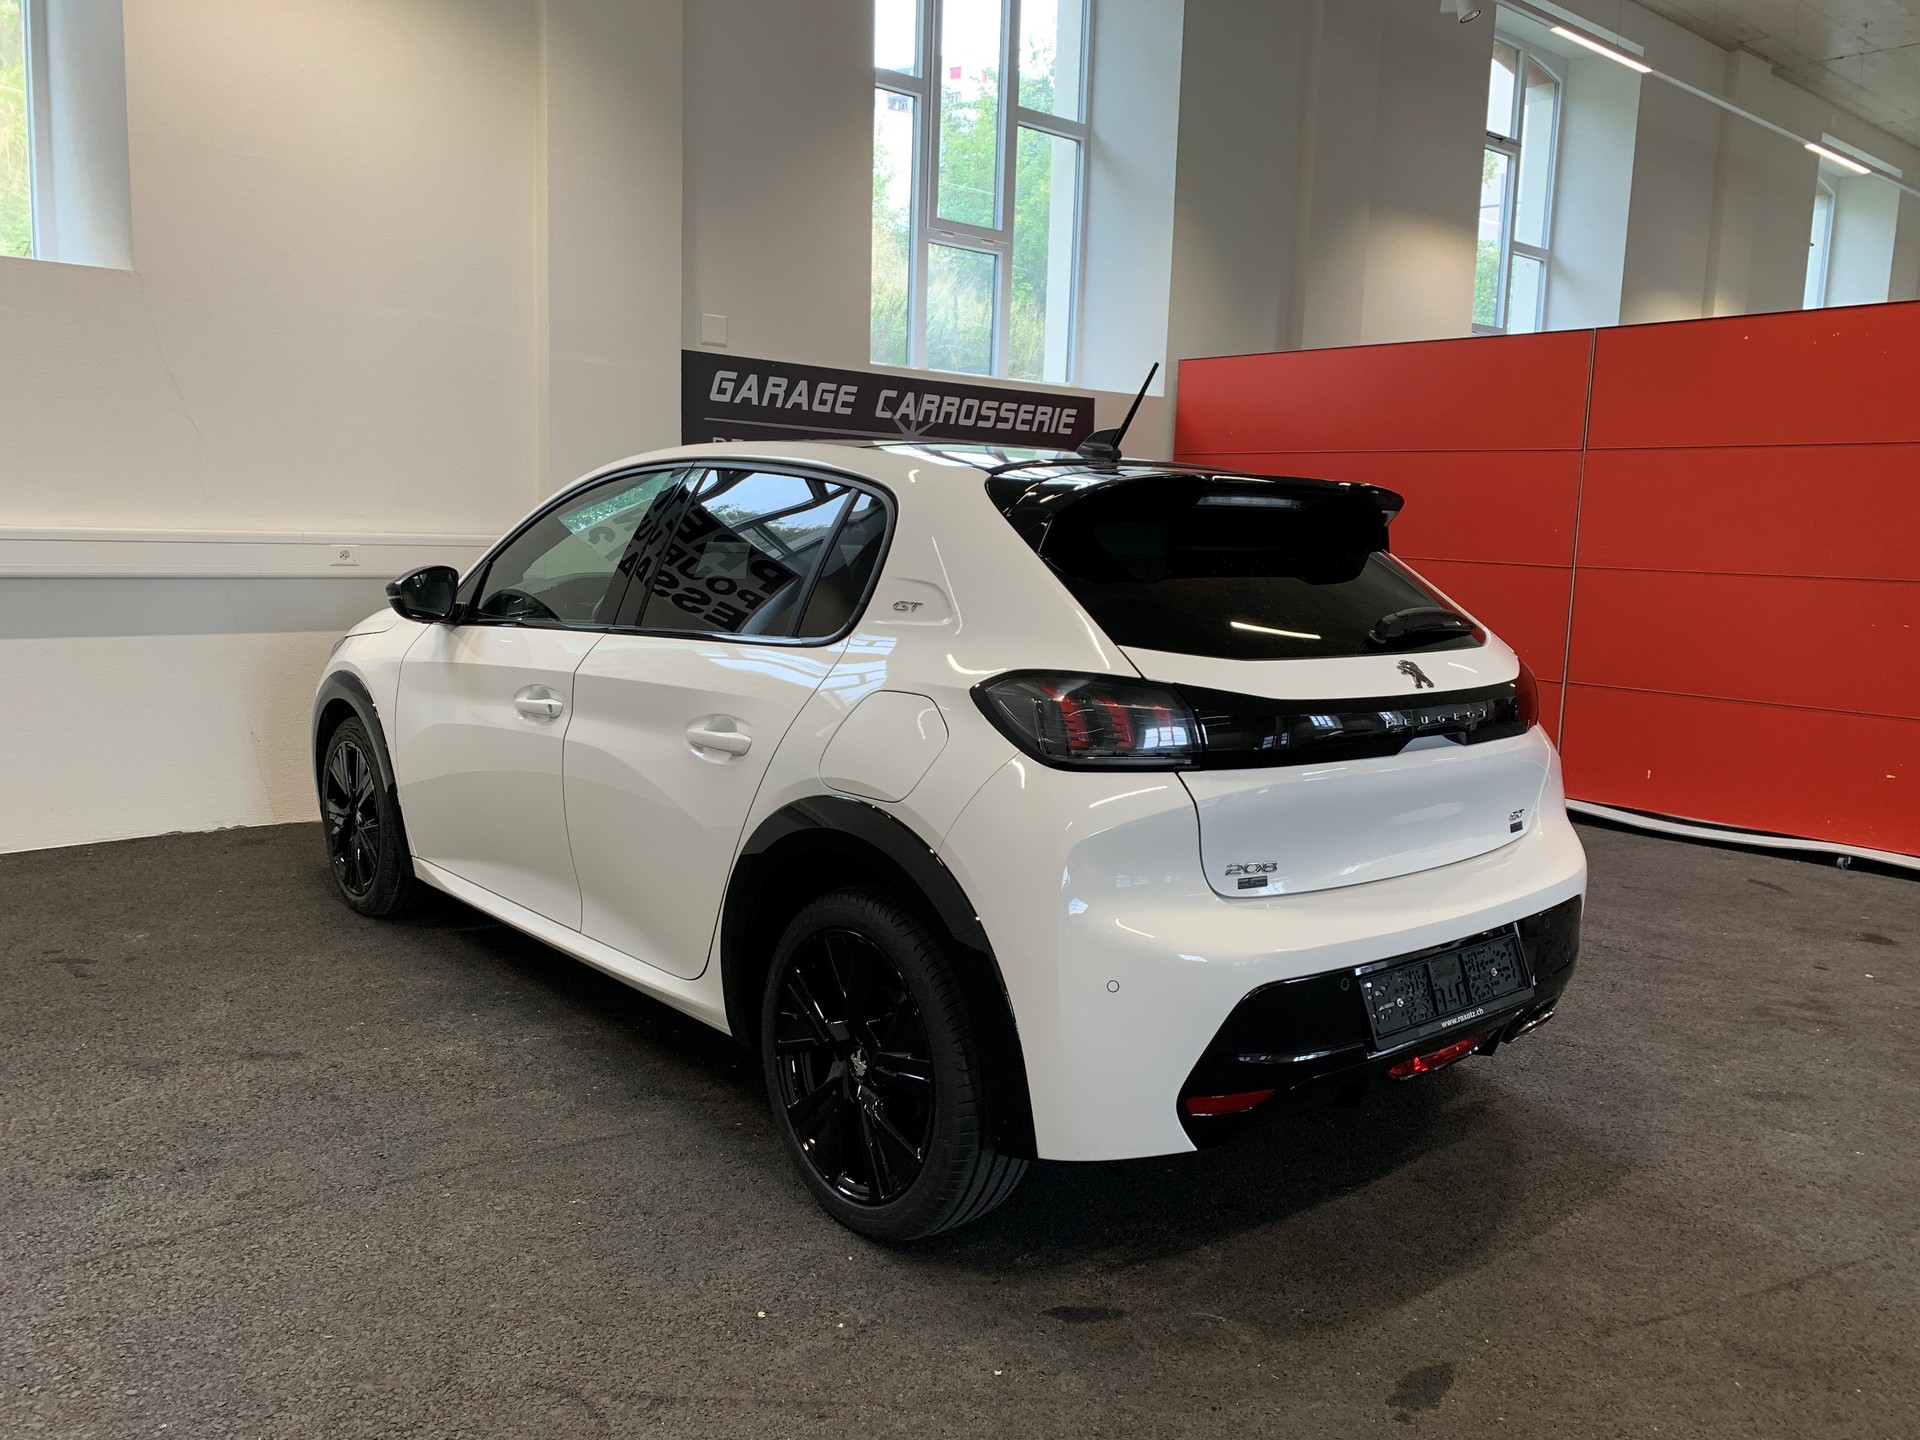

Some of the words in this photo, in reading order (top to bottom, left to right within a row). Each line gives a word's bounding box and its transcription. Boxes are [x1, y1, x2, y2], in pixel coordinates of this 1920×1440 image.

[710, 370, 858, 415] GARAGE
[875, 389, 1077, 434] CARROSSERIE
[893, 600, 924, 612] GT
[1225, 861, 1278, 876] 208
